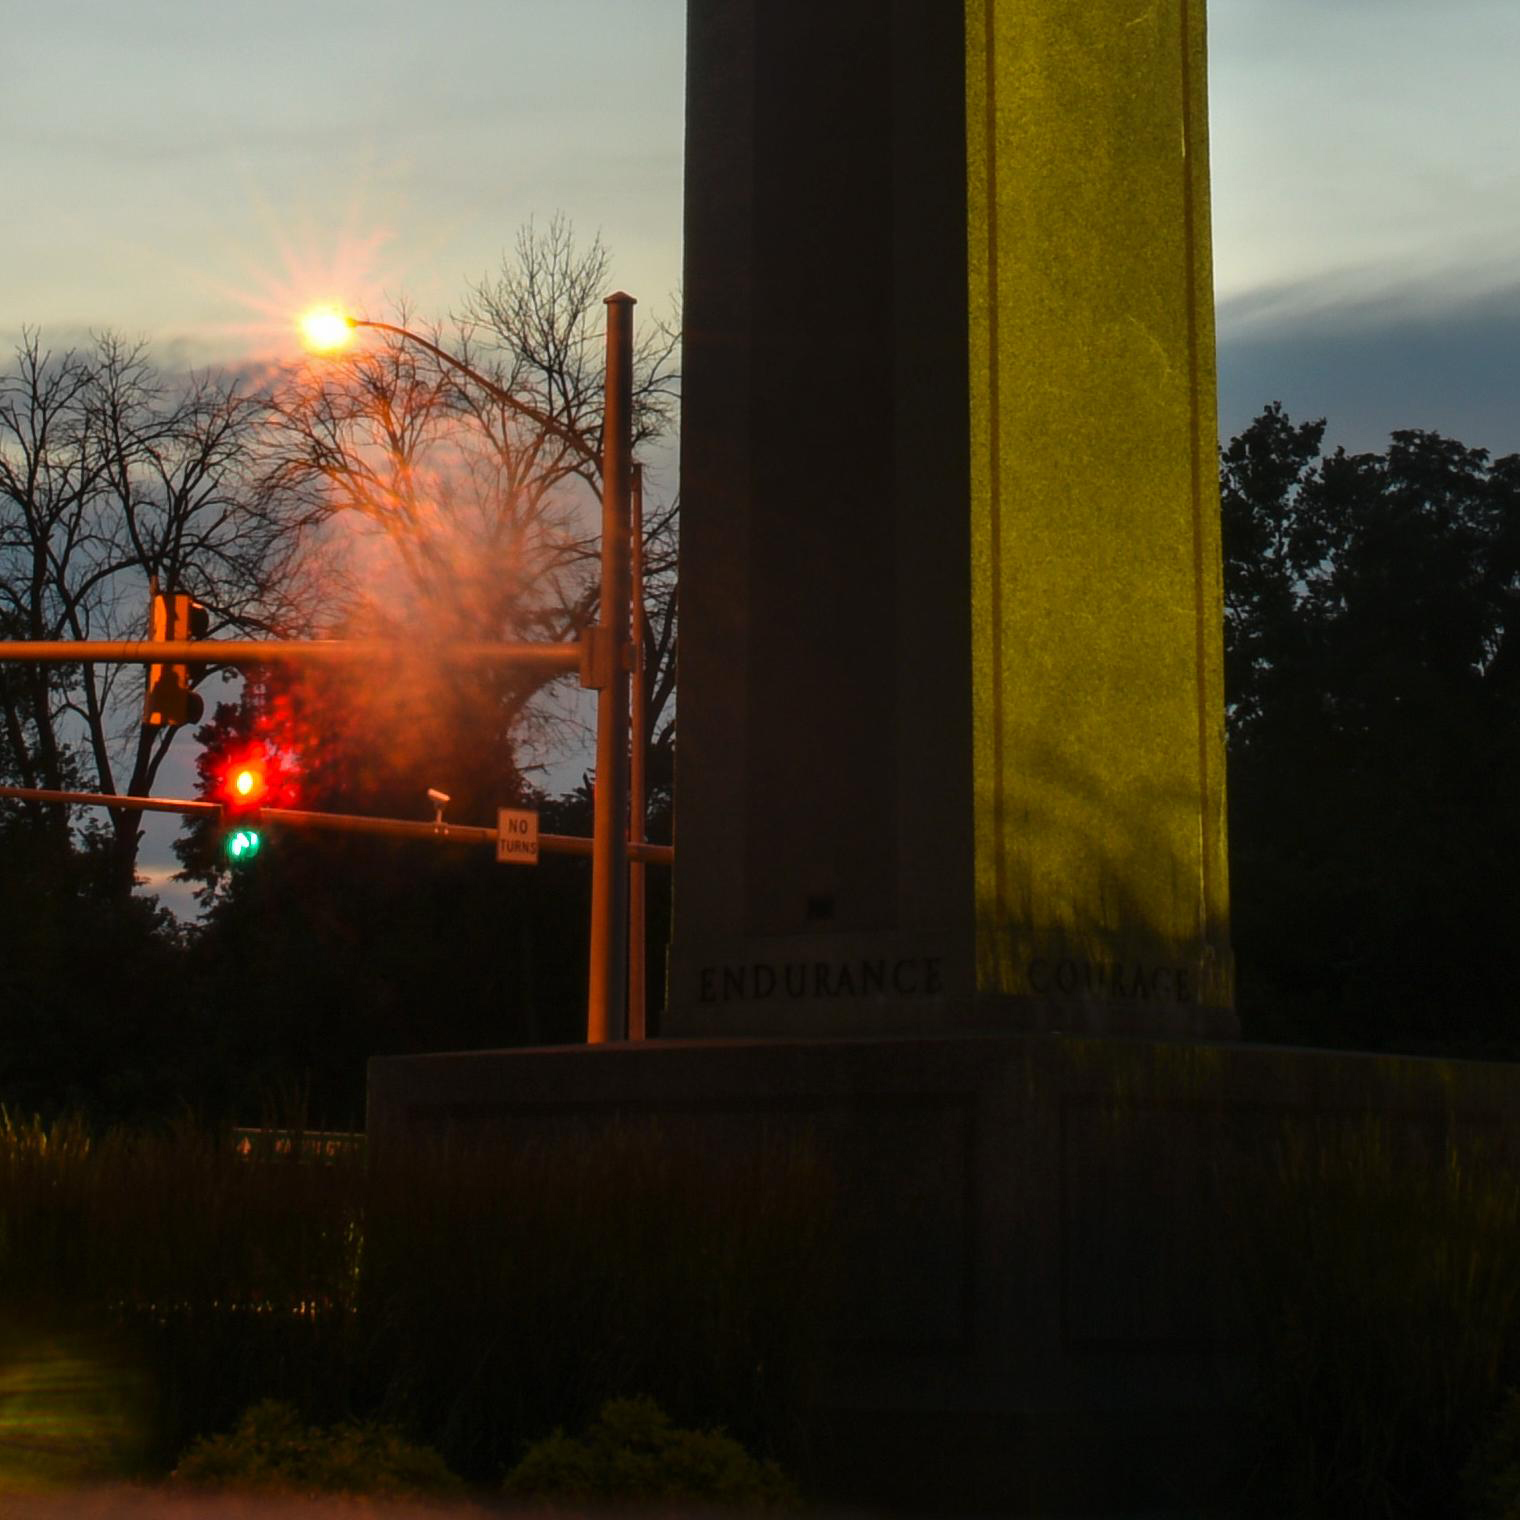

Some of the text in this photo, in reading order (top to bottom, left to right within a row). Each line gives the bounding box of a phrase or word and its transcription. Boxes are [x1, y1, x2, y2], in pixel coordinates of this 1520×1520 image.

[508, 818, 528, 834] NO
[500, 838, 537, 855] TURNS
[699, 957, 943, 1003] ENDURANCE
[1028, 957, 1191, 1002] COURAGE
